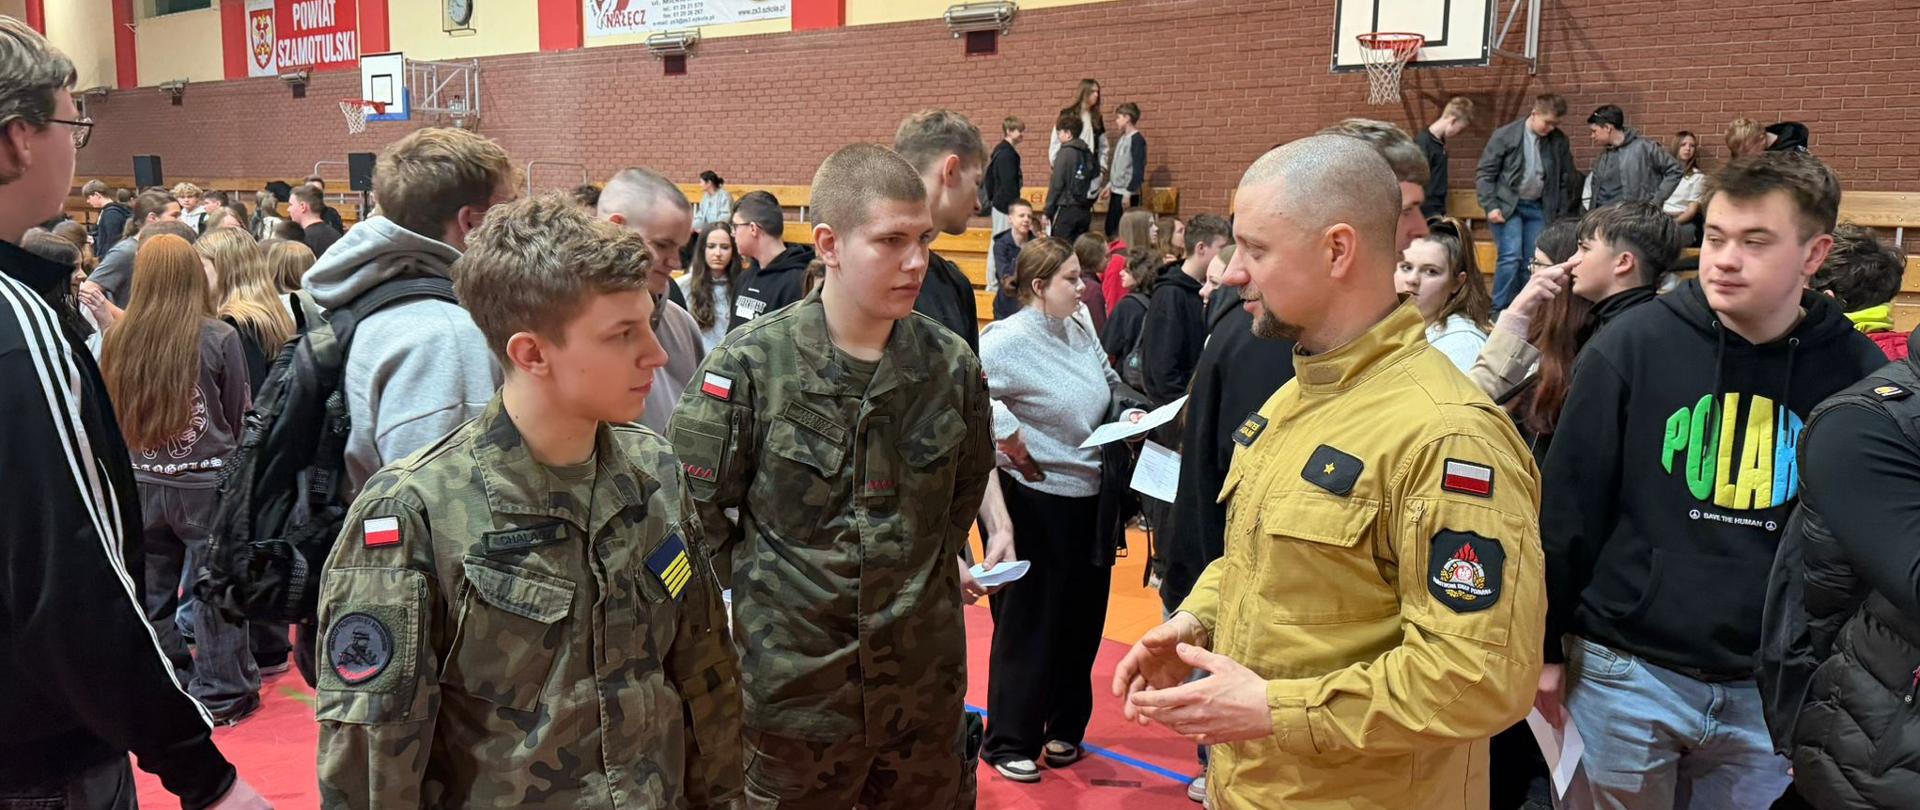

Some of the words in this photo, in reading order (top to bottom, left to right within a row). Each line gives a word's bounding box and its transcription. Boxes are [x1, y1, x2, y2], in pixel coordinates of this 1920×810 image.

[293, 0, 336, 31] POWIAT
[606, 9, 647, 30] NAŁĘCZ
[278, 31, 356, 67] SZAMOTULSKI
